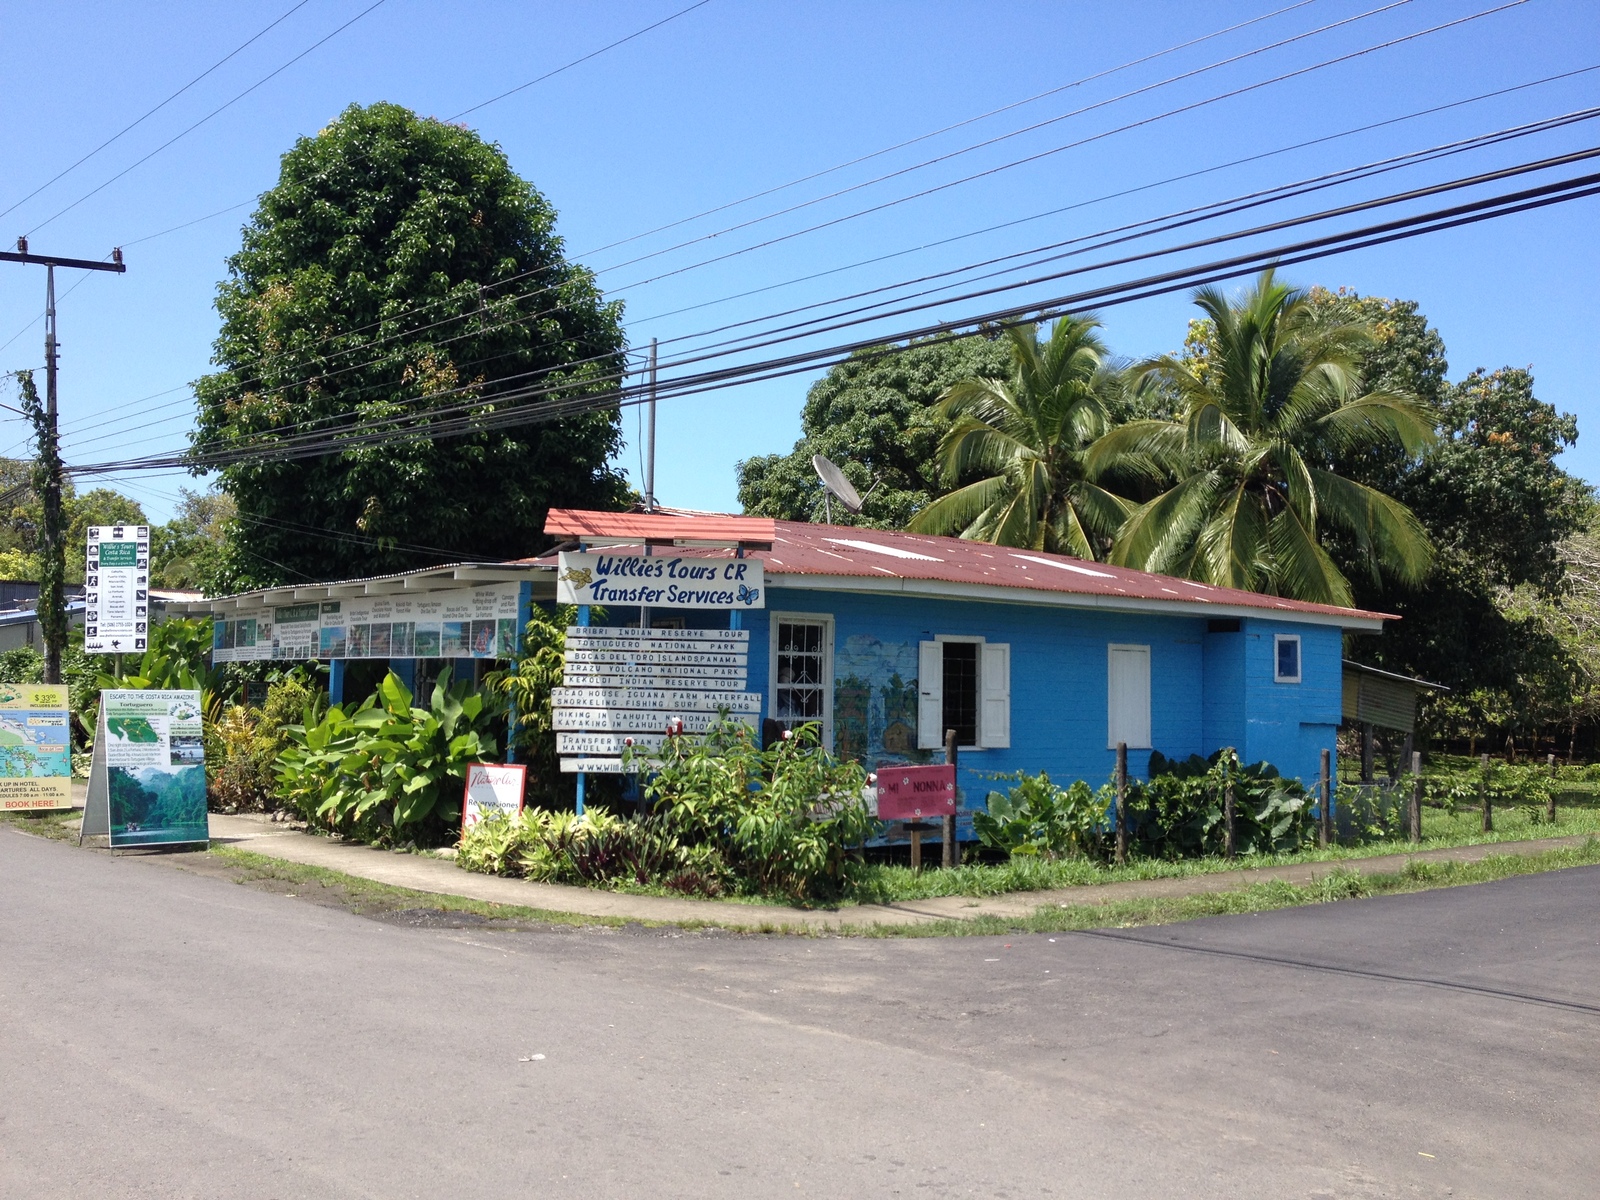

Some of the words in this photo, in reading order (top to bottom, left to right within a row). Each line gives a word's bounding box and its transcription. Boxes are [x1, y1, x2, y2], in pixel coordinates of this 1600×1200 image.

[667, 558, 718, 580] Tours
[724, 563, 748, 581] CR
[589, 579, 665, 604] Transfer
[667, 584, 734, 604] Services
[704, 693, 760, 701] WATERFALL
[562, 735, 612, 744] TRANSFER
[888, 783, 899, 794] MI
[914, 780, 946, 793] NONNA
[468, 799, 518, 808] Reervaciones
